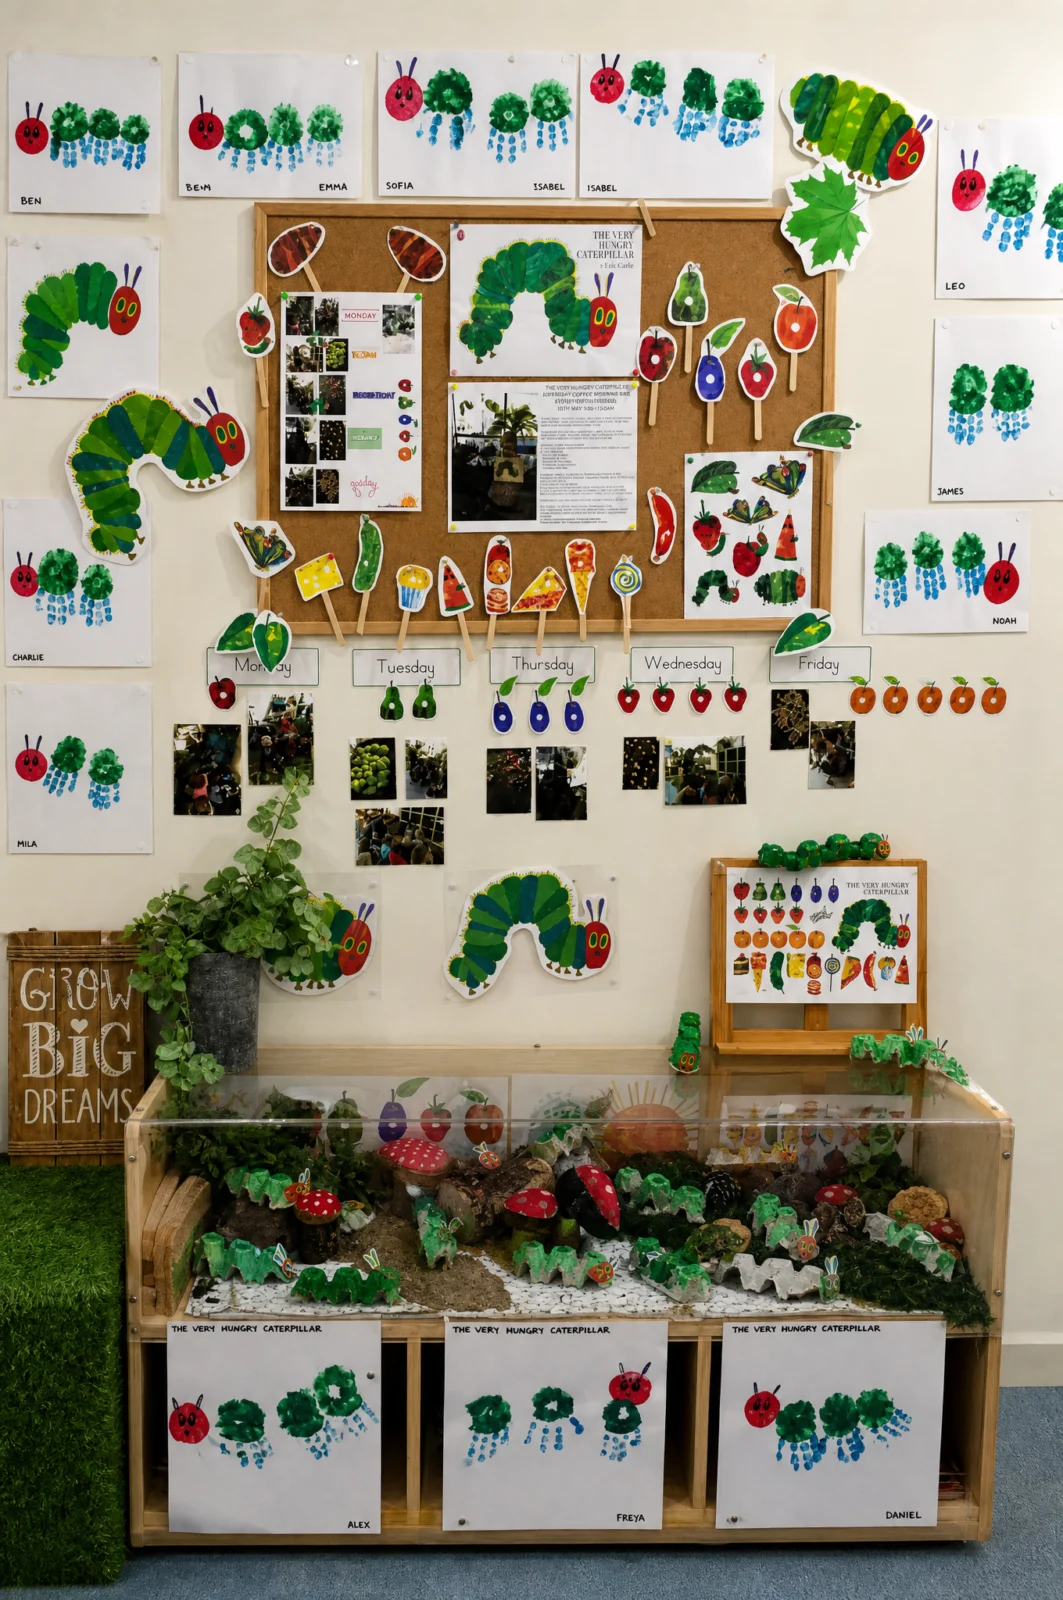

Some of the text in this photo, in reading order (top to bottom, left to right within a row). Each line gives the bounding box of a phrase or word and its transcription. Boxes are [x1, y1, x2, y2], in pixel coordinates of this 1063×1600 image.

[318, 182, 348, 192] EMMA
[385, 181, 414, 190] SOFIA
[533, 182, 566, 191] ISABEL
[587, 184, 618, 193] ISABEL
[20, 196, 42, 206] BEN
[593, 230, 634, 240] THE VERY
[599, 240, 634, 250] HUNGRY
[576, 250, 635, 259] CATERPILLAR
[945, 282, 966, 291] LEO
[937, 487, 964, 496] JAMES
[992, 617, 1017, 625] NOAH
[12, 653, 45, 662] CHARLIE
[235, 657, 291, 678] Monay
[376, 658, 436, 679] Tuesday
[511, 655, 575, 676] Thursday
[644, 655, 723, 675] Wednesday
[798, 655, 840, 675] Friday
[17, 840, 38, 848] MILA
[20, 967, 134, 1011] GROW
[25, 1088, 134, 1124] DREAMS
[171, 1324, 323, 1333] THE VERY HUNGRY CATERPILLAR
[452, 1325, 611, 1335] THE VERY HUNGRY CATERPILLAR
[731, 1324, 881, 1334] THE VERY HUNGRY CATERPILLAR
[616, 1513, 646, 1523] FREYA
[885, 1511, 922, 1520] DANIEL
[347, 1520, 371, 1529] ALEX
